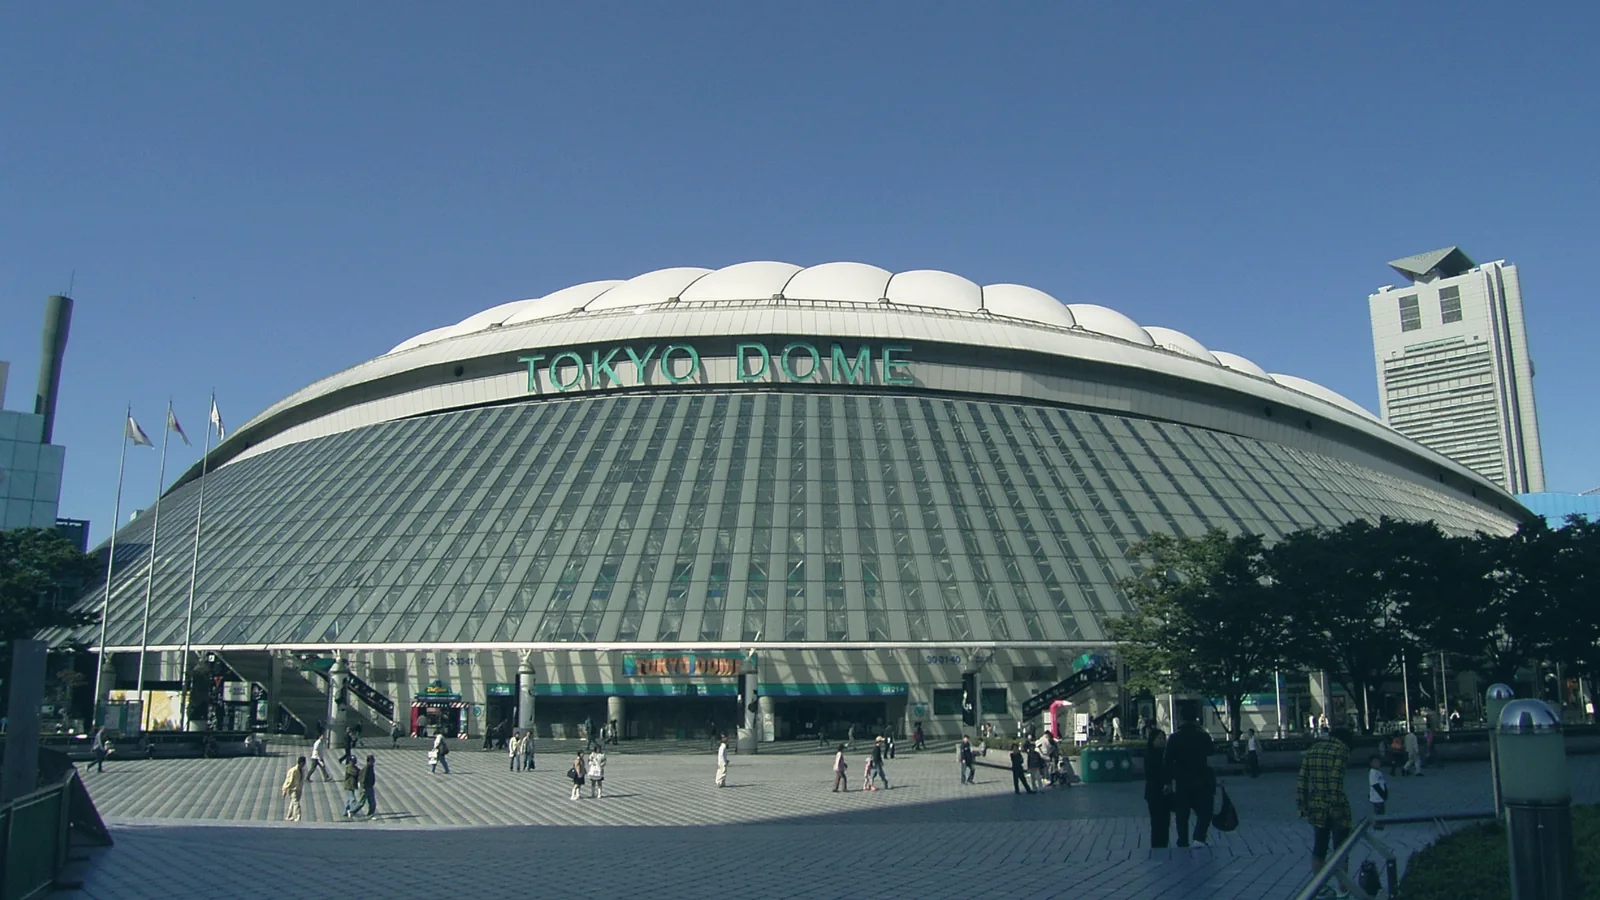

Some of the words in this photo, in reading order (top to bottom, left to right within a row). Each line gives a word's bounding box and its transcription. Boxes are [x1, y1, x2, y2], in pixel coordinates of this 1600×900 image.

[517, 343, 700, 393] TOKYO
[736, 342, 913, 385] DOME
[635, 656, 691, 676] TOKYO
